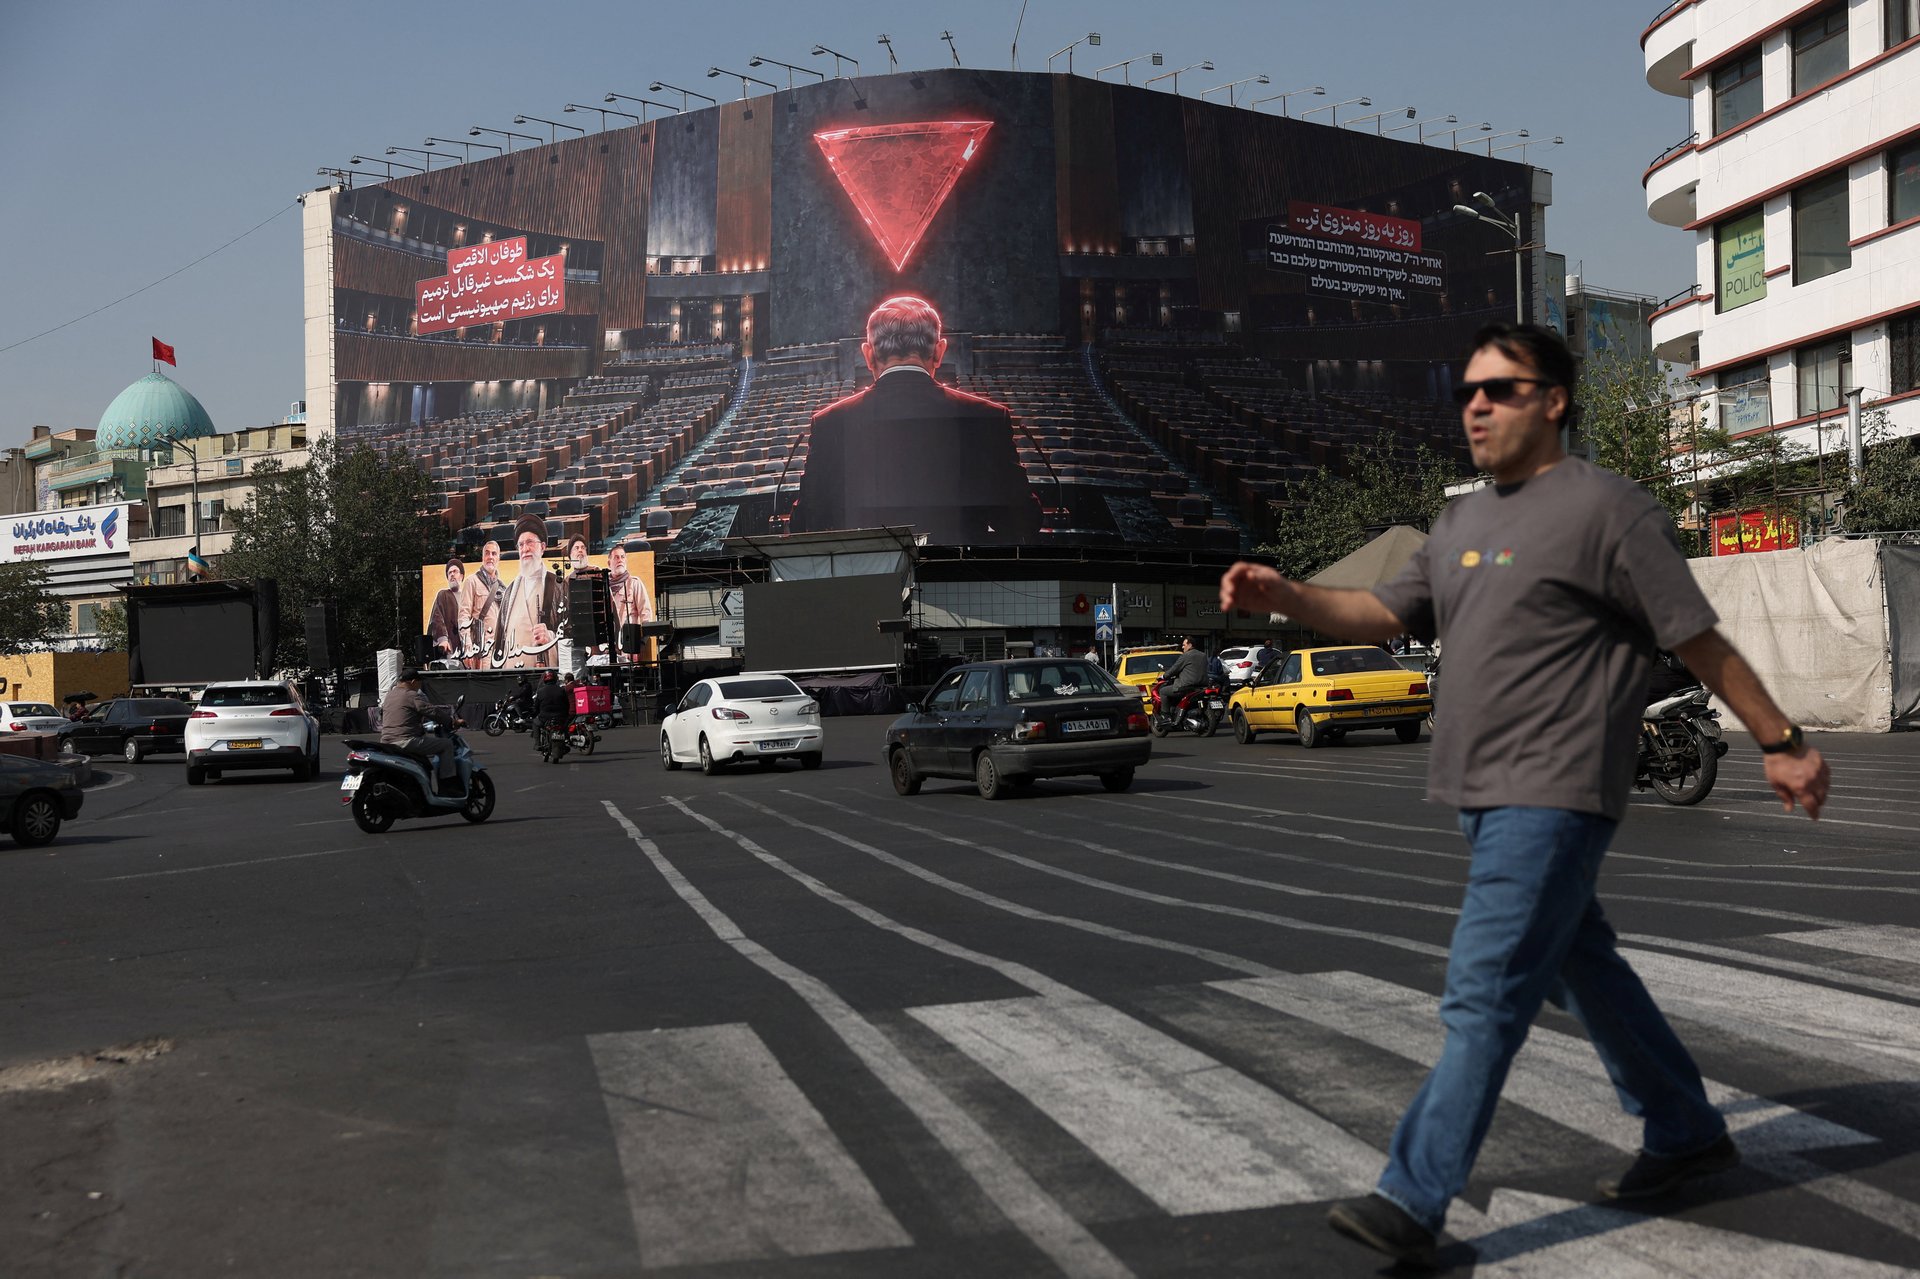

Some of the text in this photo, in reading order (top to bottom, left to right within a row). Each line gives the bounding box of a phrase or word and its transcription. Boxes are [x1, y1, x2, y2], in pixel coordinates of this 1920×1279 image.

[1321, 212, 1361, 236] منزوی
[1361, 219, 1380, 241] روز
[1382, 222, 1394, 243] به
[1395, 224, 1414, 247] روز
[452, 241, 523, 274] طوفان الاقصی
[1270, 251, 1289, 264] כבר
[1291, 253, 1317, 268] שלכם
[1726, 233, 1765, 269] لیس
[537, 260, 555, 279] یک
[1420, 256, 1442, 269] אחרי
[494, 264, 535, 286] شکست
[1311, 274, 1341, 290] בעולם
[1373, 266, 1407, 282] לשקרים
[421, 281, 450, 307] ترمیم
[1377, 285, 1387, 297] מי
[420, 284, 559, 324] برای رژیم صهیونیستی است
[14, 538, 97, 555] REFAH KARGARAN BANK
